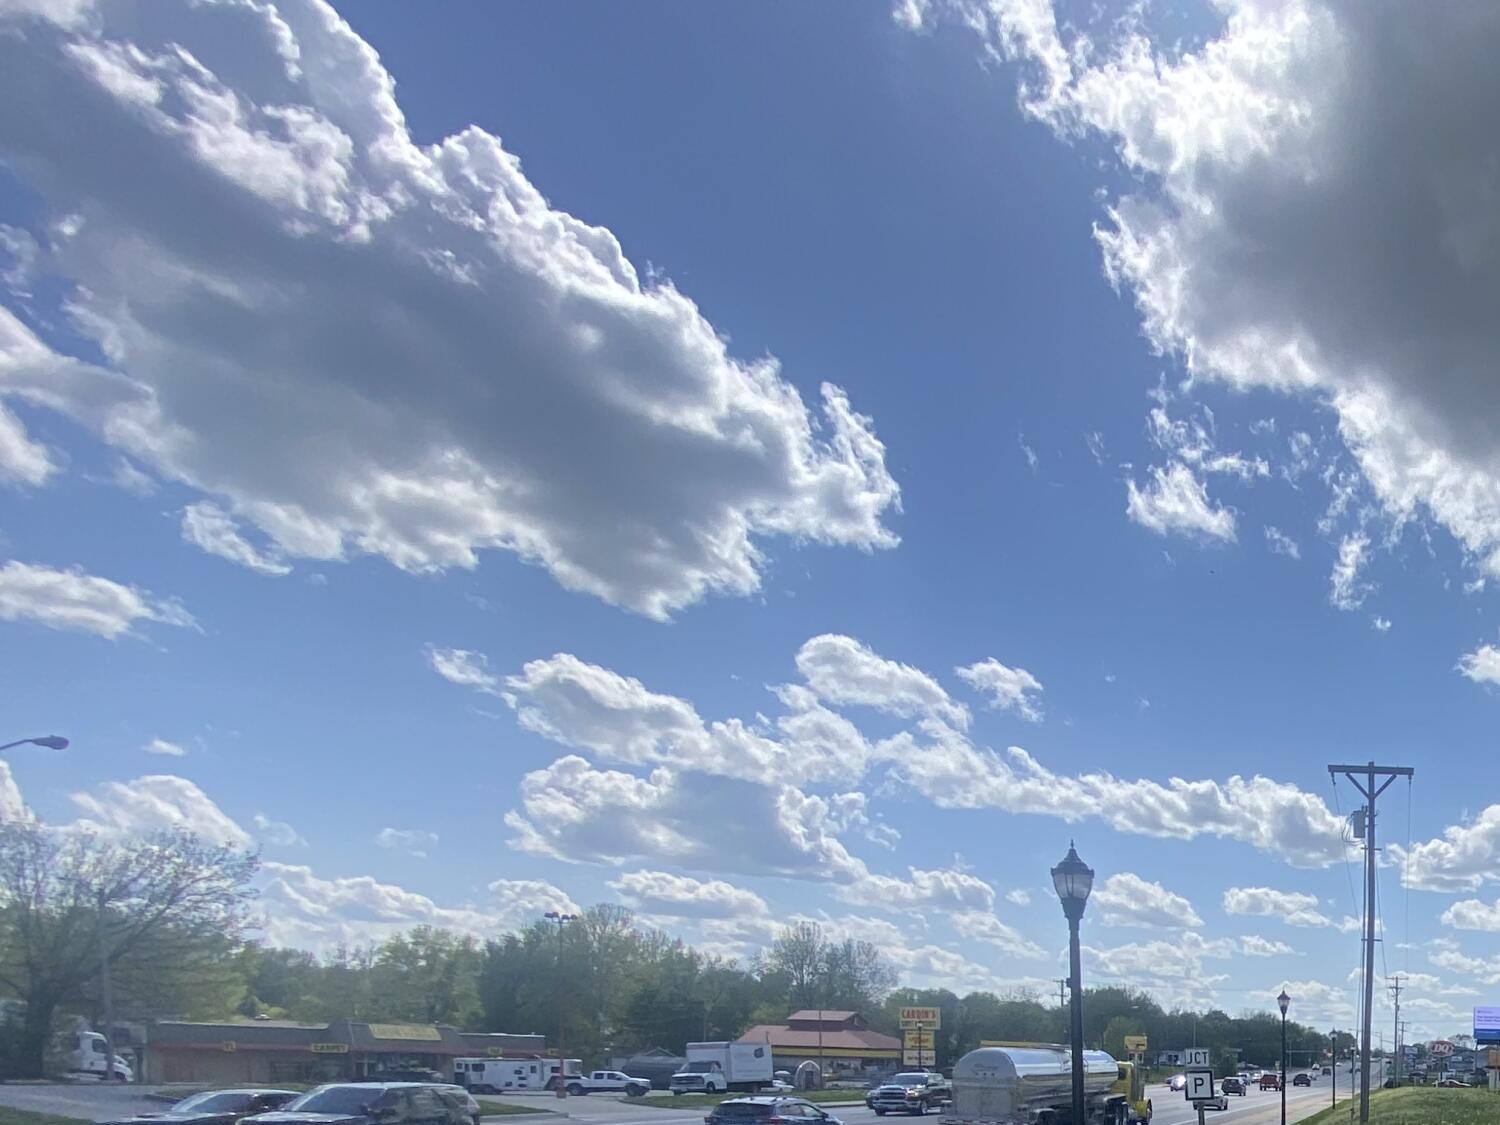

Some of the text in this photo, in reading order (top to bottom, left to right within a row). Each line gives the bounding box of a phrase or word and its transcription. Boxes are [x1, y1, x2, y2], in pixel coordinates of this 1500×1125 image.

[1433, 1044, 1449, 1053] DQ
[1187, 1052, 1208, 1064] JCT
[1194, 1077, 1204, 1093] P
